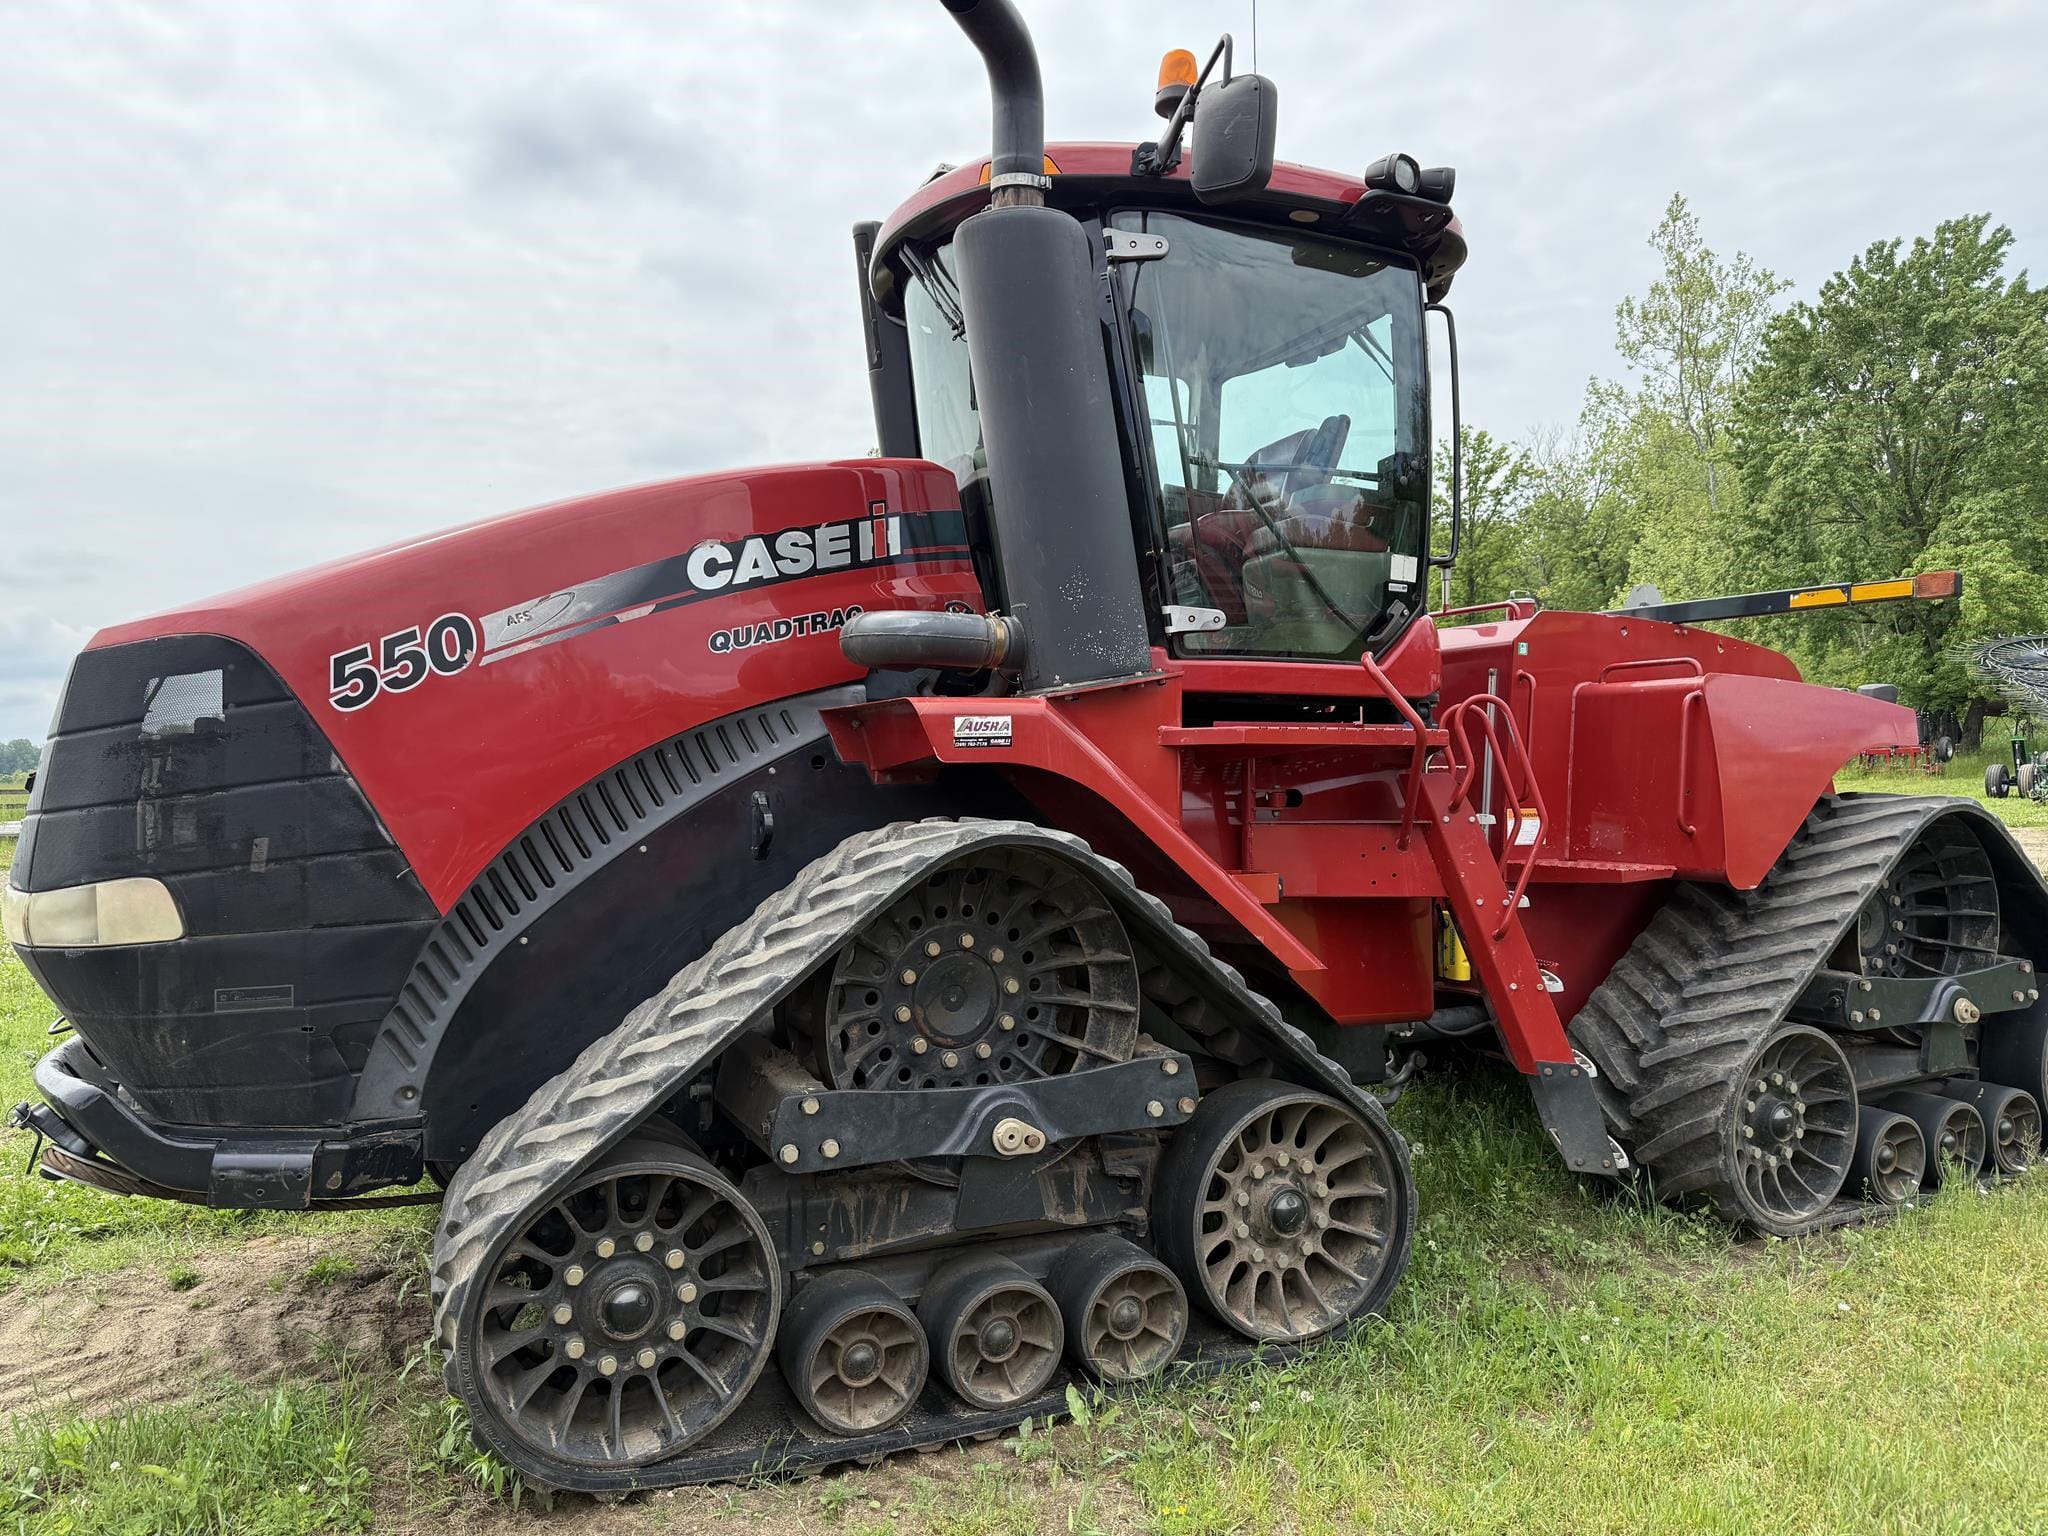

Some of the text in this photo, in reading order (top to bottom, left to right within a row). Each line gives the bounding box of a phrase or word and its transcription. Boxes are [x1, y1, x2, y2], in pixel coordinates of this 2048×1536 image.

[686, 525, 852, 590] CASE
[507, 610, 532, 626] AFS
[328, 612, 477, 712] 550
